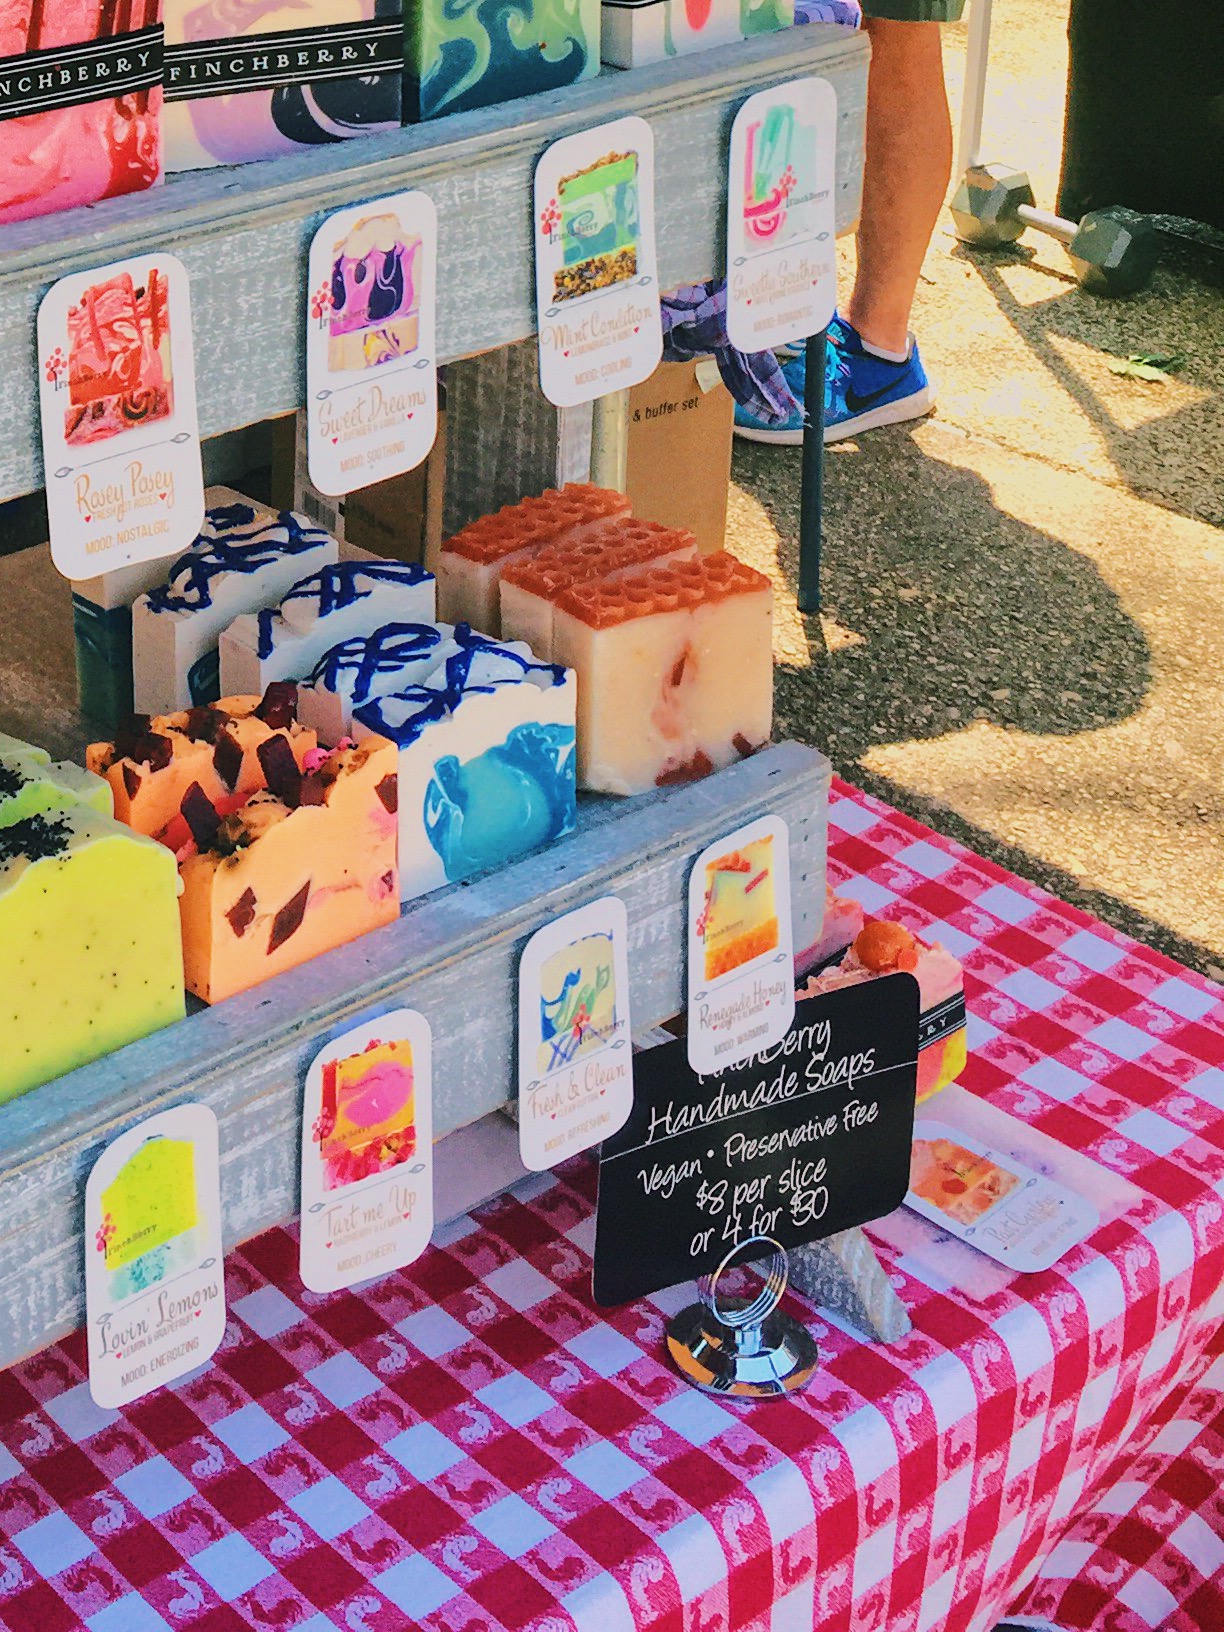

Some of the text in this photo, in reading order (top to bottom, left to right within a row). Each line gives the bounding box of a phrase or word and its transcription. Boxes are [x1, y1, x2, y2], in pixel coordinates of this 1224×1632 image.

[169, 42, 379, 81] FINCHBERRY
[540, 319, 589, 350] Mint
[319, 385, 426, 437] Sweet Dreams
[633, 397, 699, 422] & buffer set
[117, 519, 169, 545] NOSTALGIC
[753, 980, 787, 1006] Honey
[527, 1082, 564, 1119] Fresh
[584, 1062, 626, 1091] Clean
[645, 1047, 877, 1146] Handmade Soaps
[637, 1099, 880, 1199] Vegan Preservative Free
[318, 1184, 417, 1237] Tart me Up
[696, 1158, 828, 1217] $8 per slice
[690, 1185, 829, 1256] or 4 for $30
[156, 1282, 218, 1327] Lemons
[150, 1336, 199, 1372] ENERGIZING
